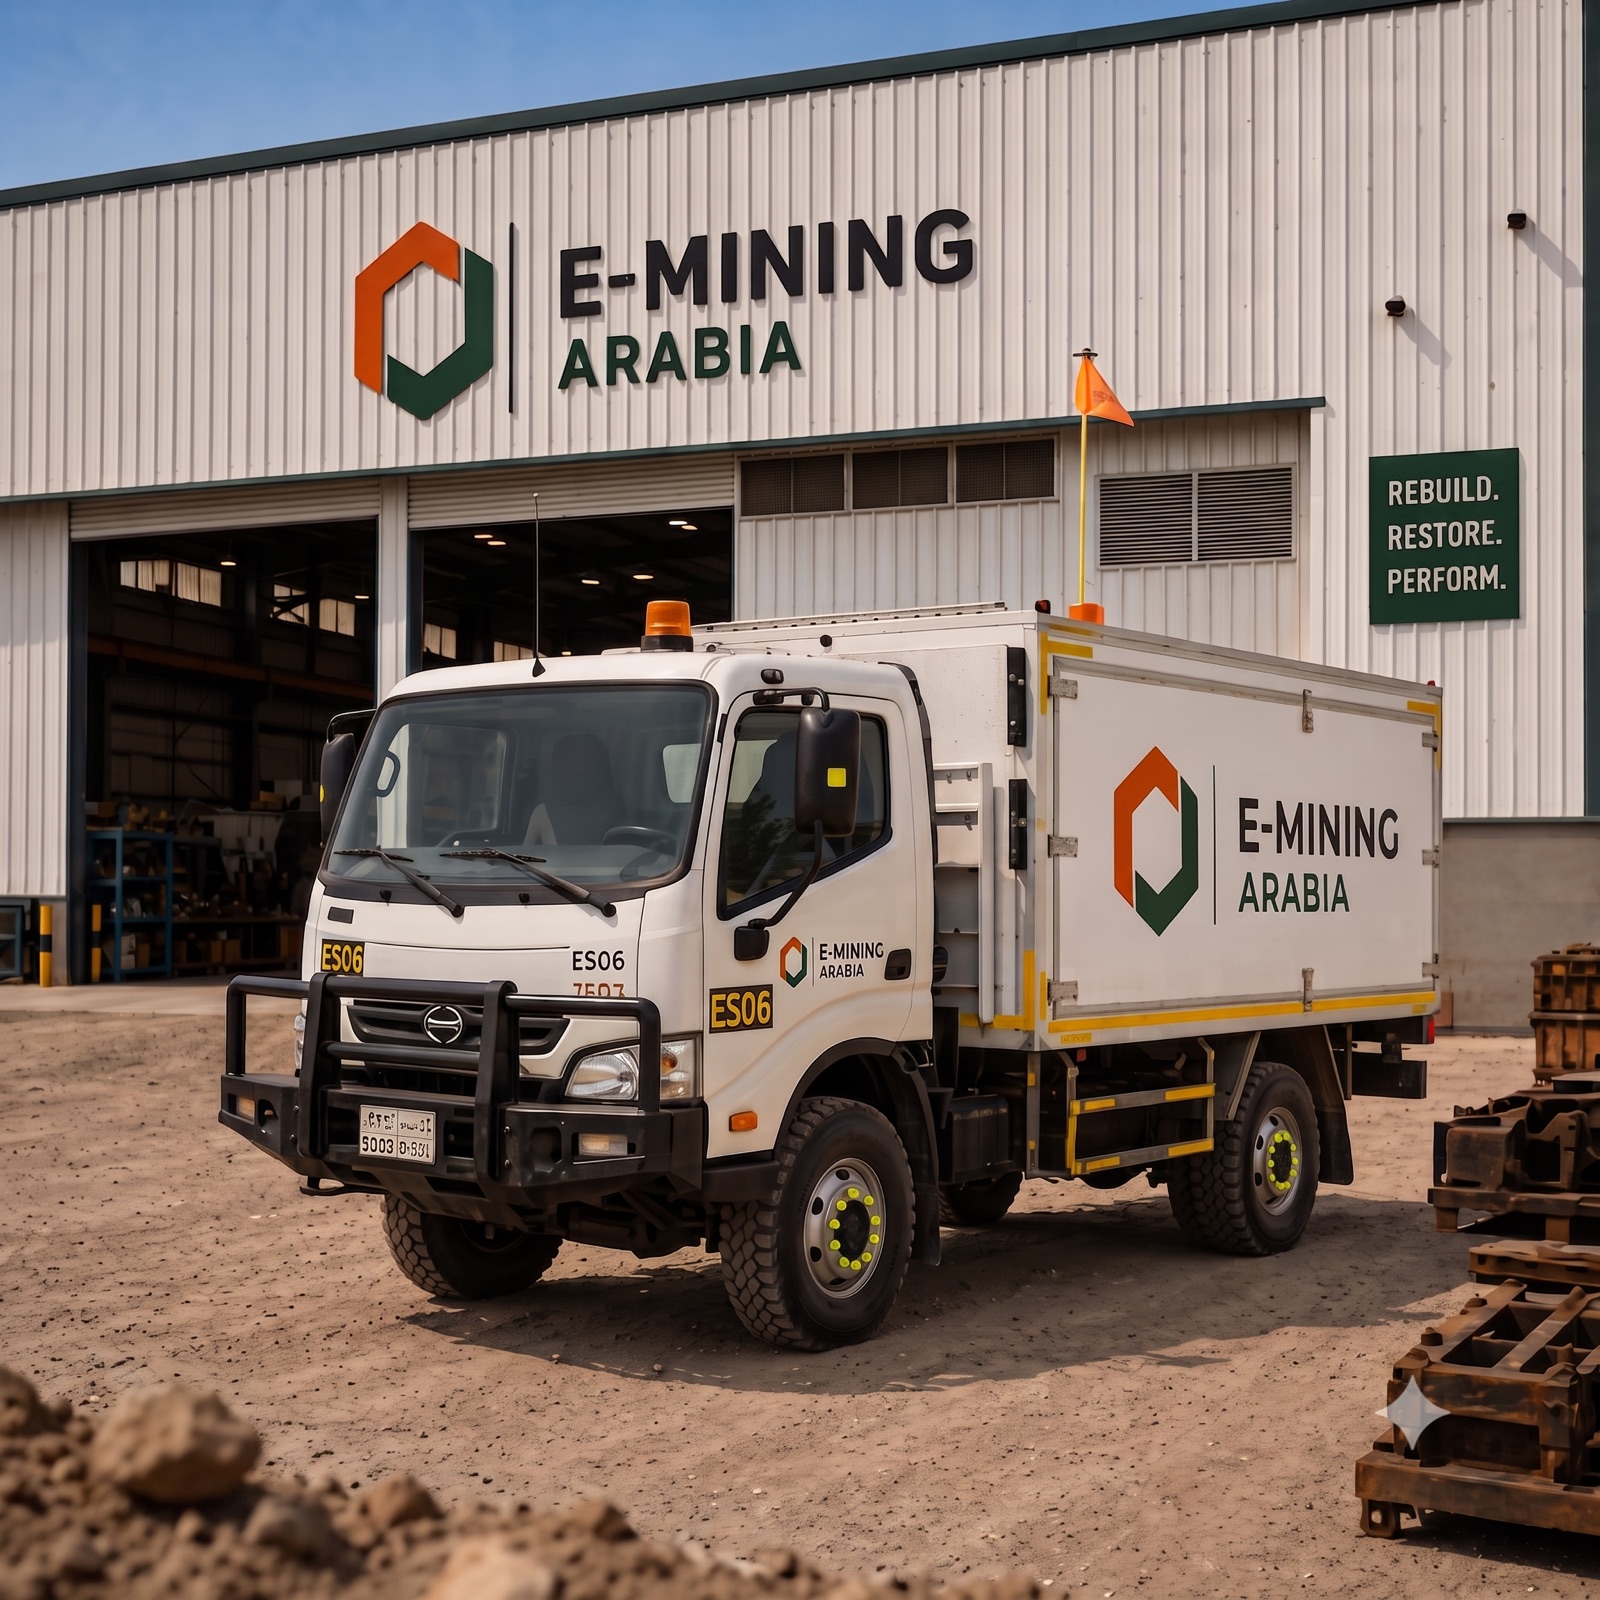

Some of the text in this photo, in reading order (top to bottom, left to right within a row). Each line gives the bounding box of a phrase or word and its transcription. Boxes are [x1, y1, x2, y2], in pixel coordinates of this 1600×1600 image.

[560, 209, 974, 318] E-MINING
[558, 321, 802, 389] ARABIA
[1388, 475, 1499, 506] REBUILD.
[1388, 519, 1503, 551] RESTORE.
[1387, 564, 1507, 594] PERFORM.
[1239, 797, 1399, 859] E-MINING
[1238, 872, 1350, 912] ARABIA
[321, 943, 363, 974] ES06
[572, 950, 625, 971] ES06
[819, 942, 884, 960] E-MINING
[819, 964, 864, 979] ARABIA
[711, 990, 771, 1028] ES06
